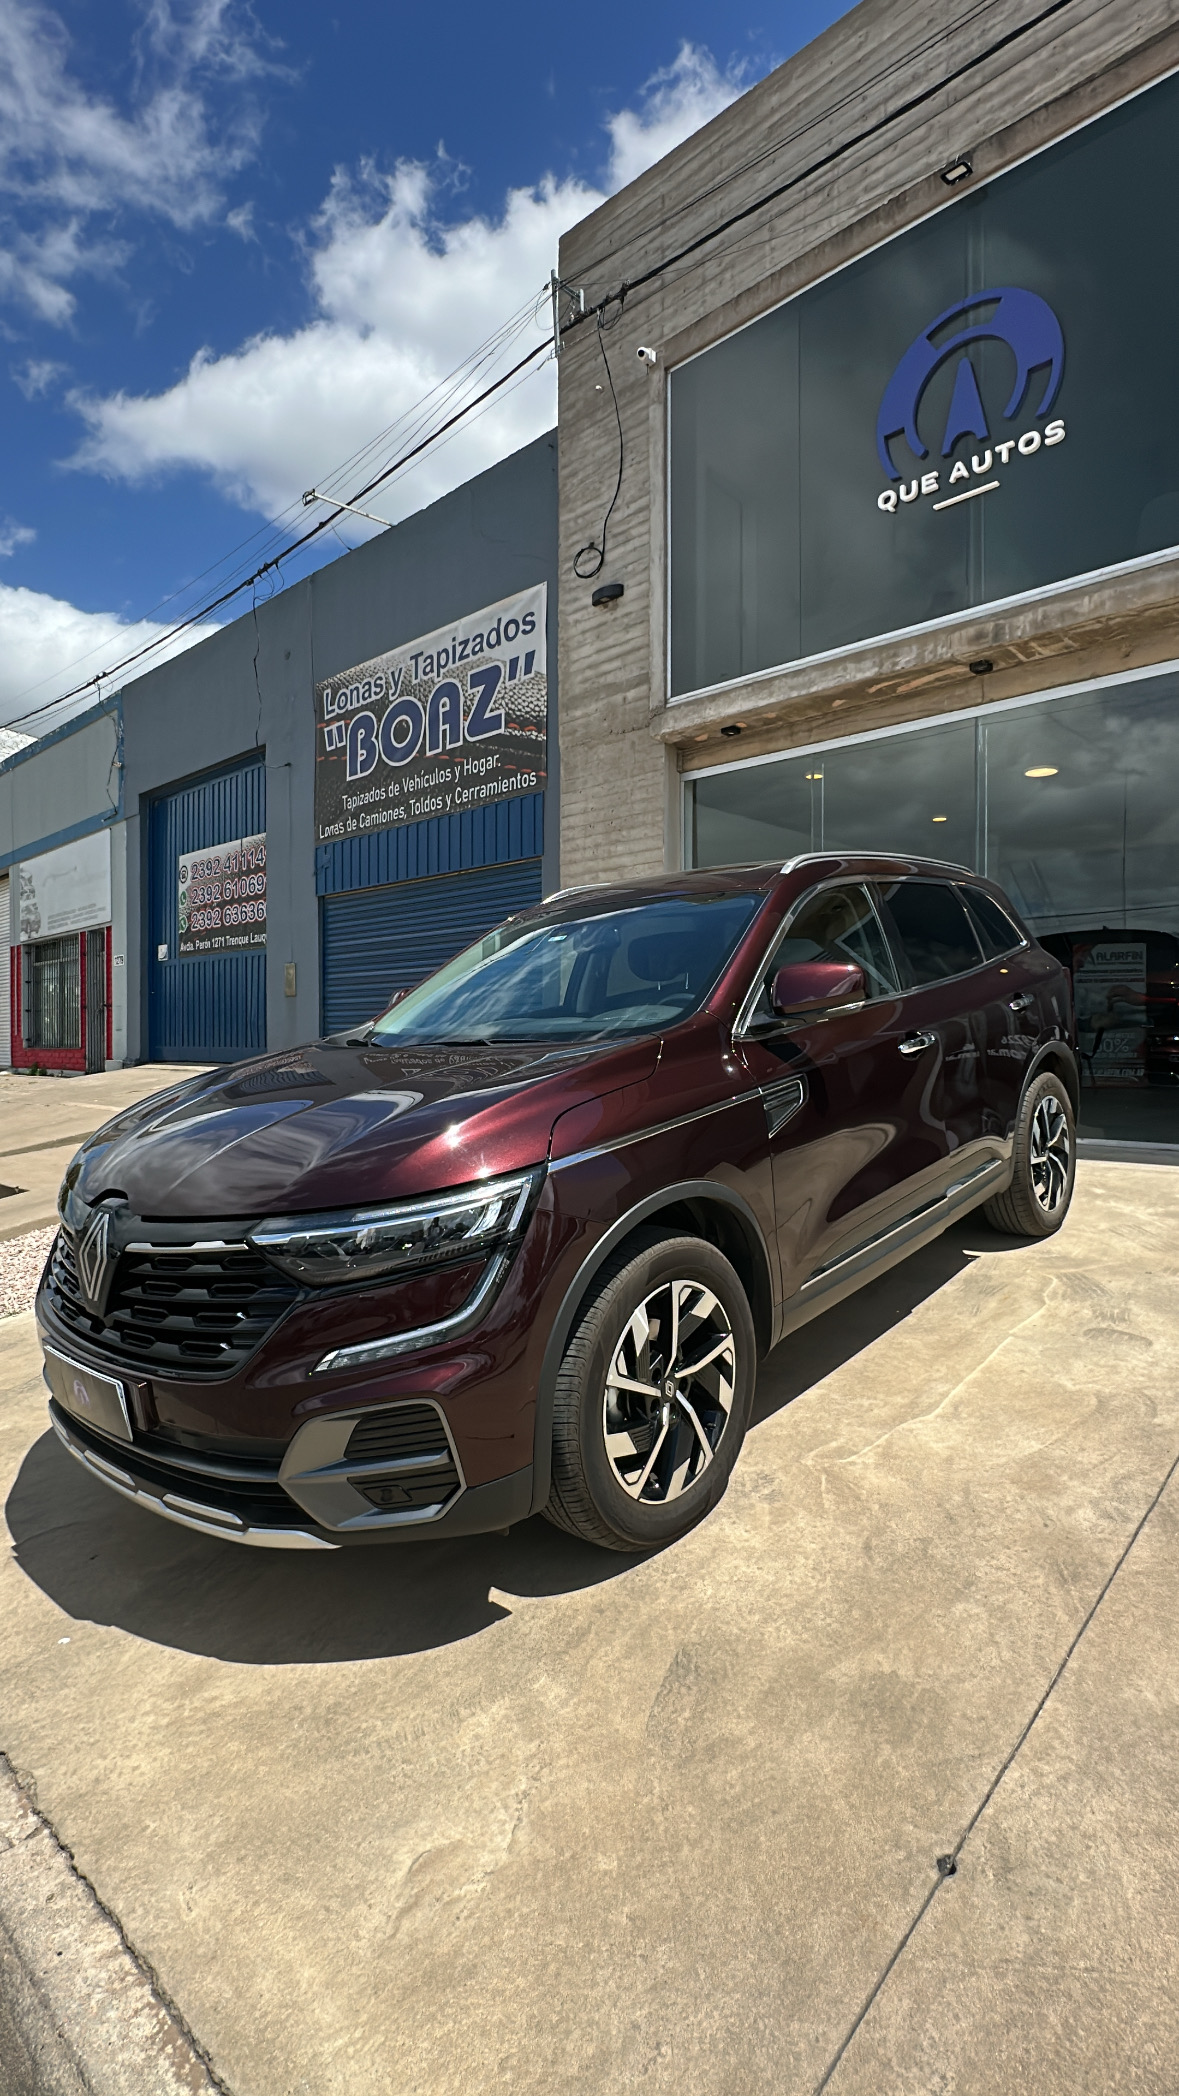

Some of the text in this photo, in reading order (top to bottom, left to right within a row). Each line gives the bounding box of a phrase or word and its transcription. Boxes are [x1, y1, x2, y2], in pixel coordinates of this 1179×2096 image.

[877, 419, 1066, 513] QUE AUTOS
[324, 611, 536, 720] Lonas y Tapizados
[320, 771, 537, 839] Lonas de Camiones, Toldos y Cerramientos
[342, 754, 501, 811] Tapizados de Vehículos y Hogar.
[191, 846, 266, 881] 2392 41114
[191, 874, 266, 906] 2392 61069
[191, 900, 266, 931] 2392 63636
[250, 932, 266, 944] Lauq
